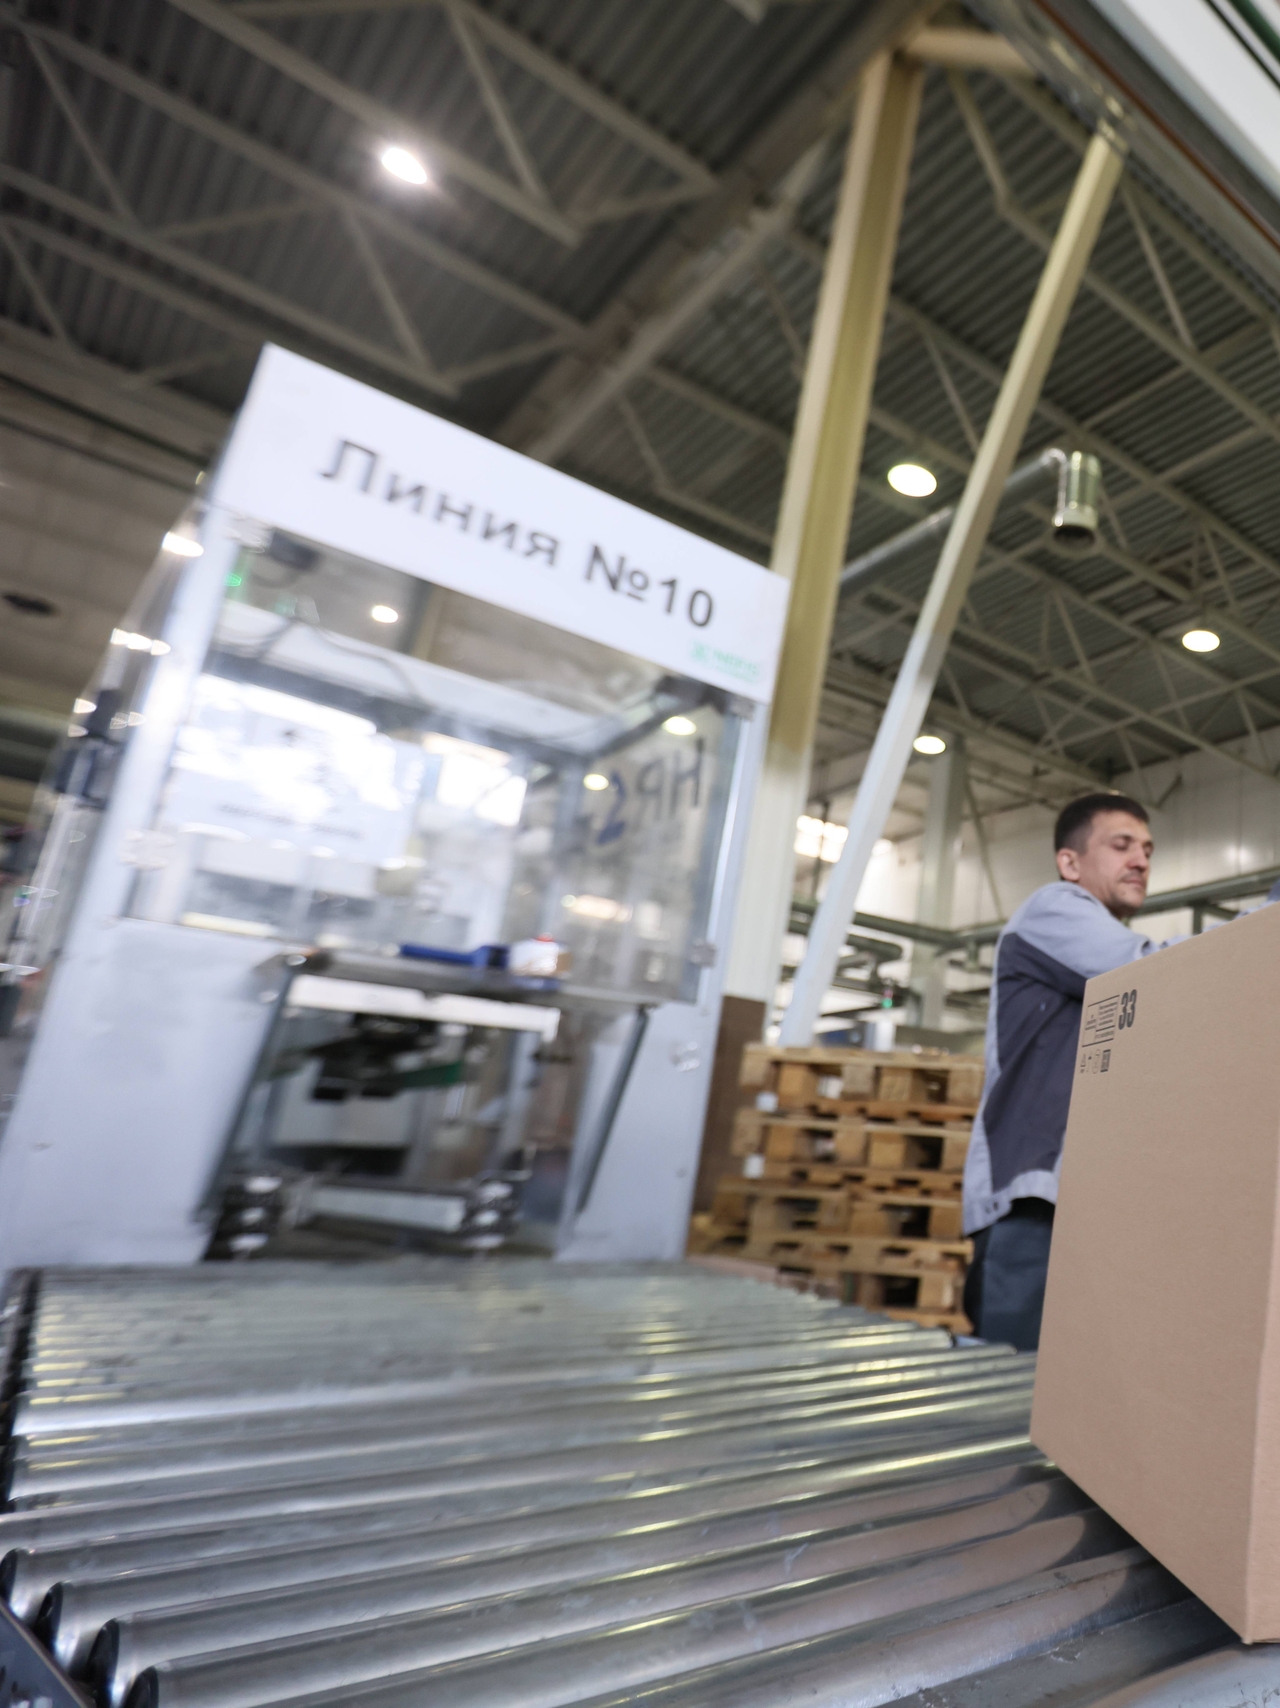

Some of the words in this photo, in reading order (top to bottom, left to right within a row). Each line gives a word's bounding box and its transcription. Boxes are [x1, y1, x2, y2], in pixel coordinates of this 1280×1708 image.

[317, 438, 562, 568] Линия
[584, 543, 714, 628] №10
[1118, 989, 1137, 1030] 33
